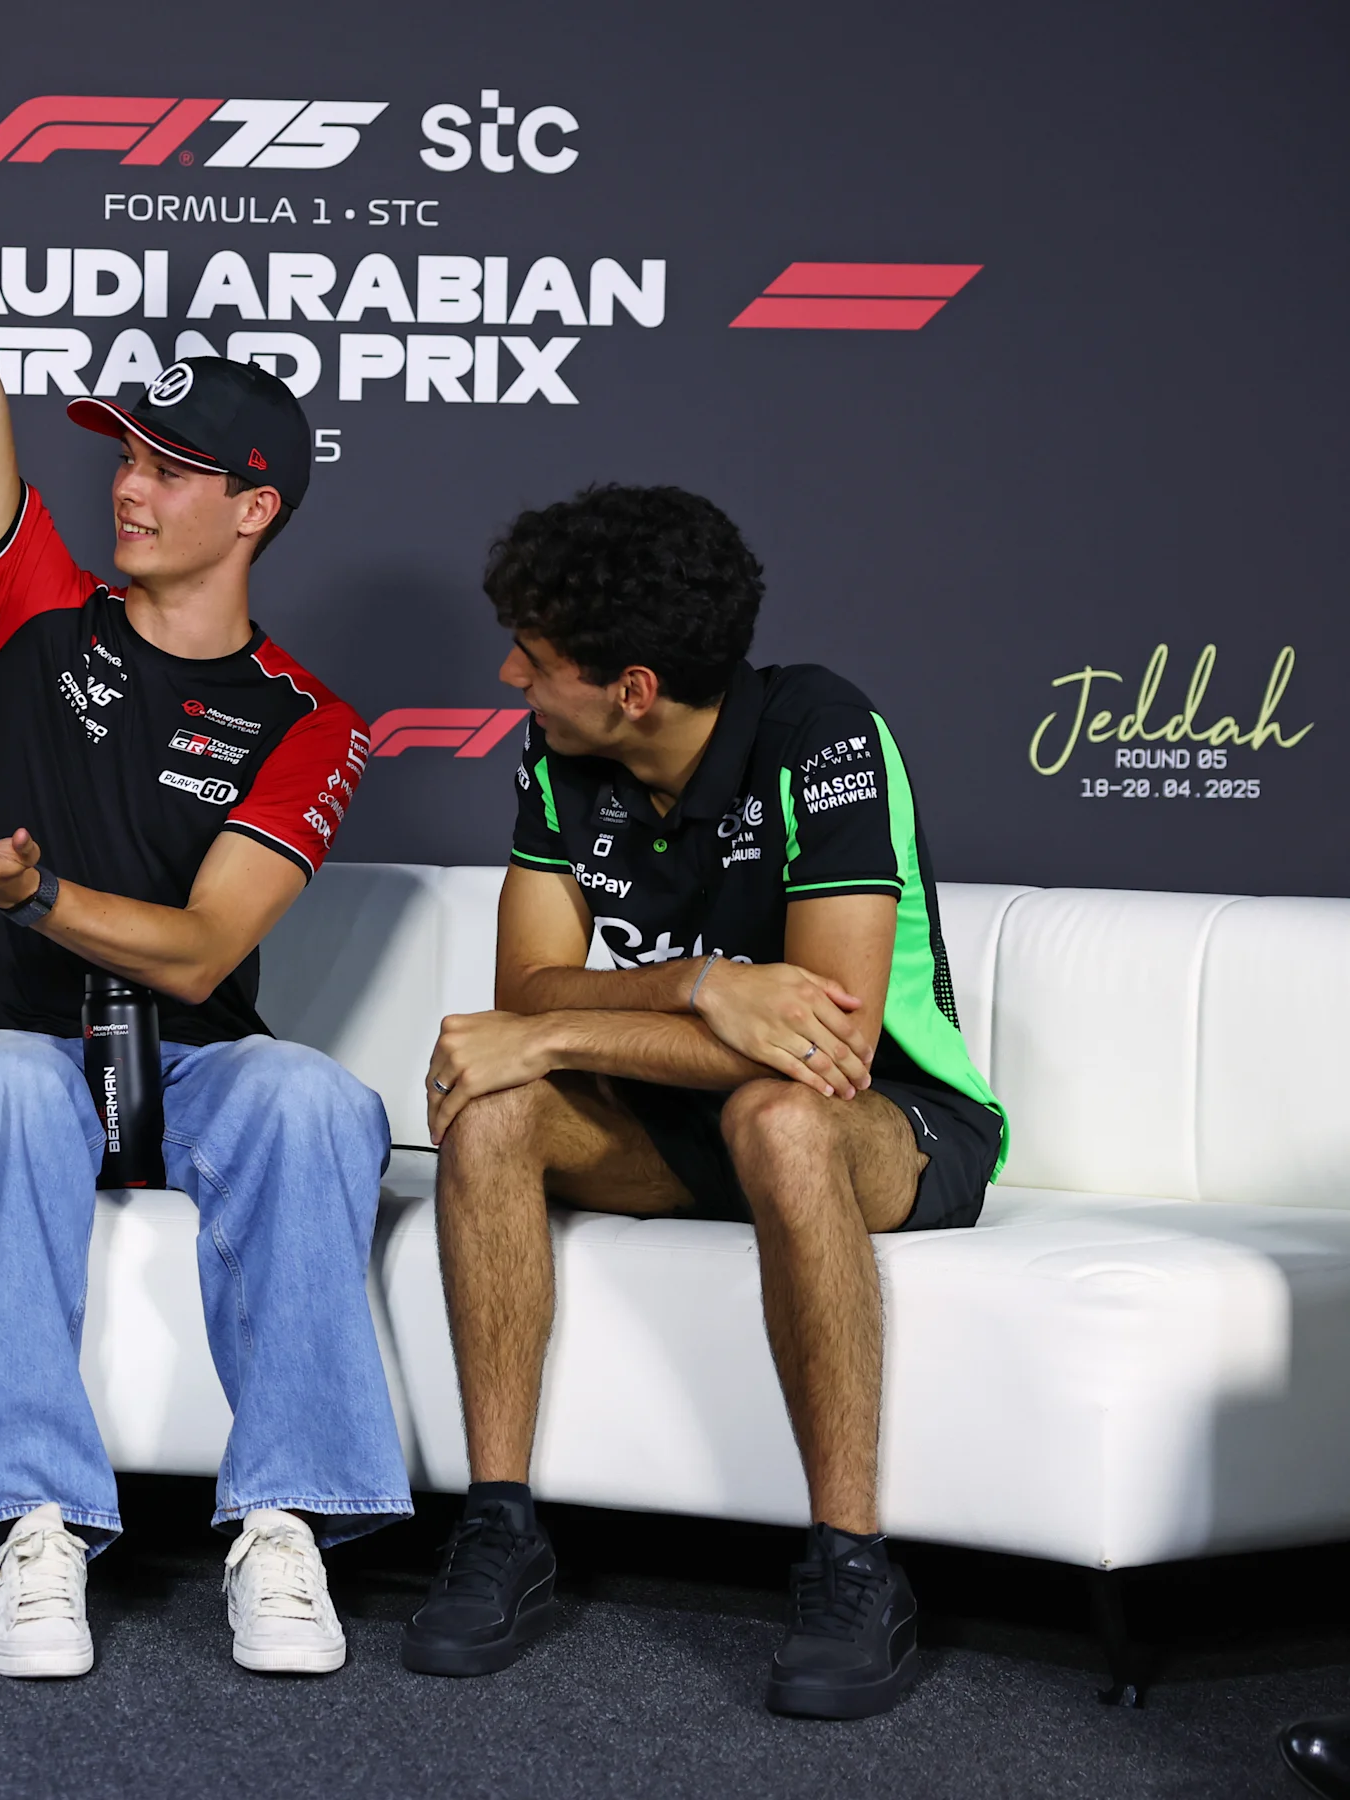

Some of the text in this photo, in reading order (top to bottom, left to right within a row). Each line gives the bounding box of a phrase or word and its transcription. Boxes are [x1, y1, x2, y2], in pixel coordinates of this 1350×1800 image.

[203, 99, 390, 169] 75
[419, 89, 580, 174] stc
[104, 194, 440, 227] FORMULA 1 STC
[186, 250, 667, 328] ARABIAN
[340, 332, 581, 404] PRIX
[1029, 642, 1314, 775] Jeddah
[171, 737, 206, 754] GR
[203, 750, 241, 765] Racing
[206, 744, 244, 759] GAZOO
[211, 738, 250, 754] TOYOTA
[1115, 748, 1228, 770] ROUND 05
[199, 780, 232, 802] GO
[803, 771, 875, 803] MASCOT
[807, 787, 878, 815] WORKWEAR
[1080, 778, 1261, 799] 18-20.04.2025
[103, 1066, 121, 1153] BEARMAN
